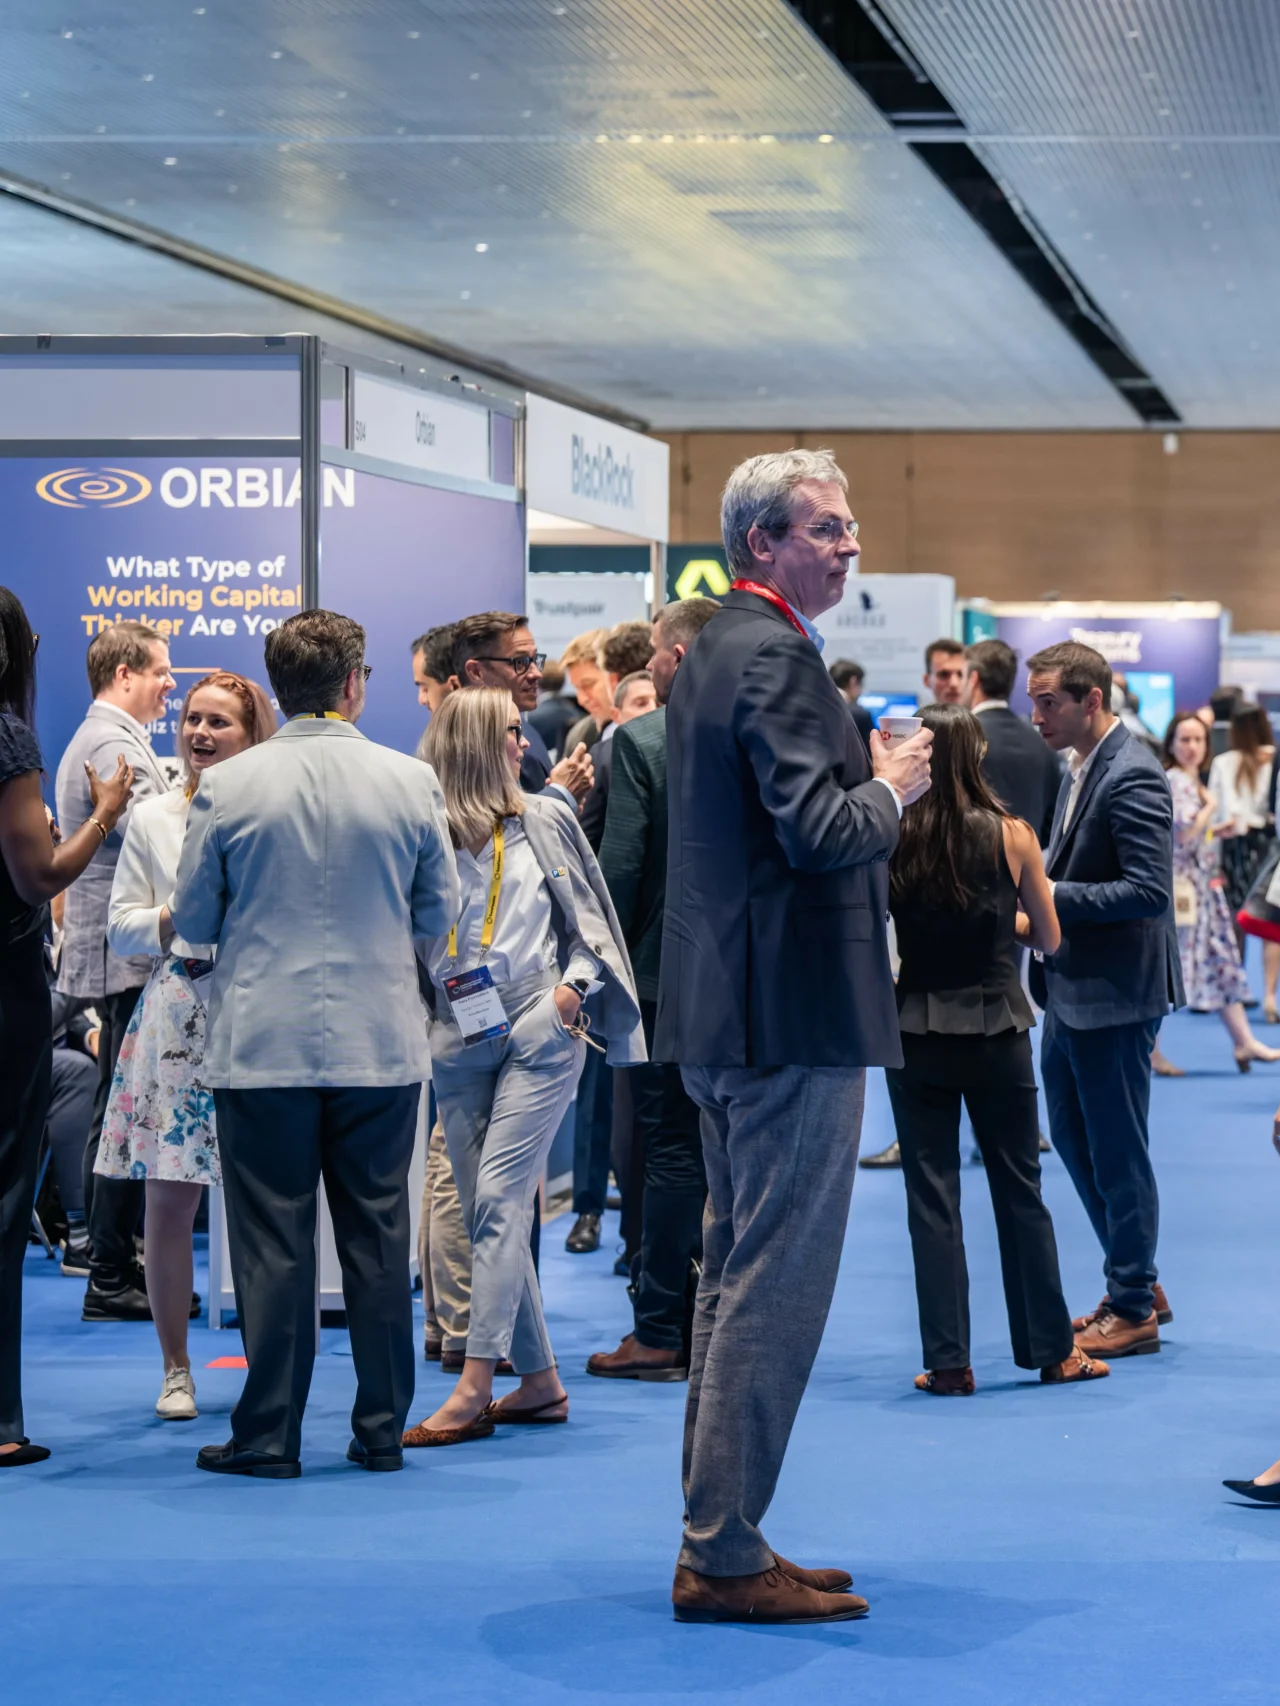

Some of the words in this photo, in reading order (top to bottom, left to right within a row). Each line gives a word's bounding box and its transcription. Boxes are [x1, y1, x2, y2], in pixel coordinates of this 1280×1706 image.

[415, 410, 437, 446] Orbian
[571, 434, 635, 509] BlackRock
[106, 556, 180, 578] What
[186, 556, 251, 582] Type
[257, 555, 286, 578] of
[87, 584, 203, 612] Working
[210, 583, 302, 612] Capital
[81, 612, 184, 636] Thiker
[189, 614, 237, 636] Are
